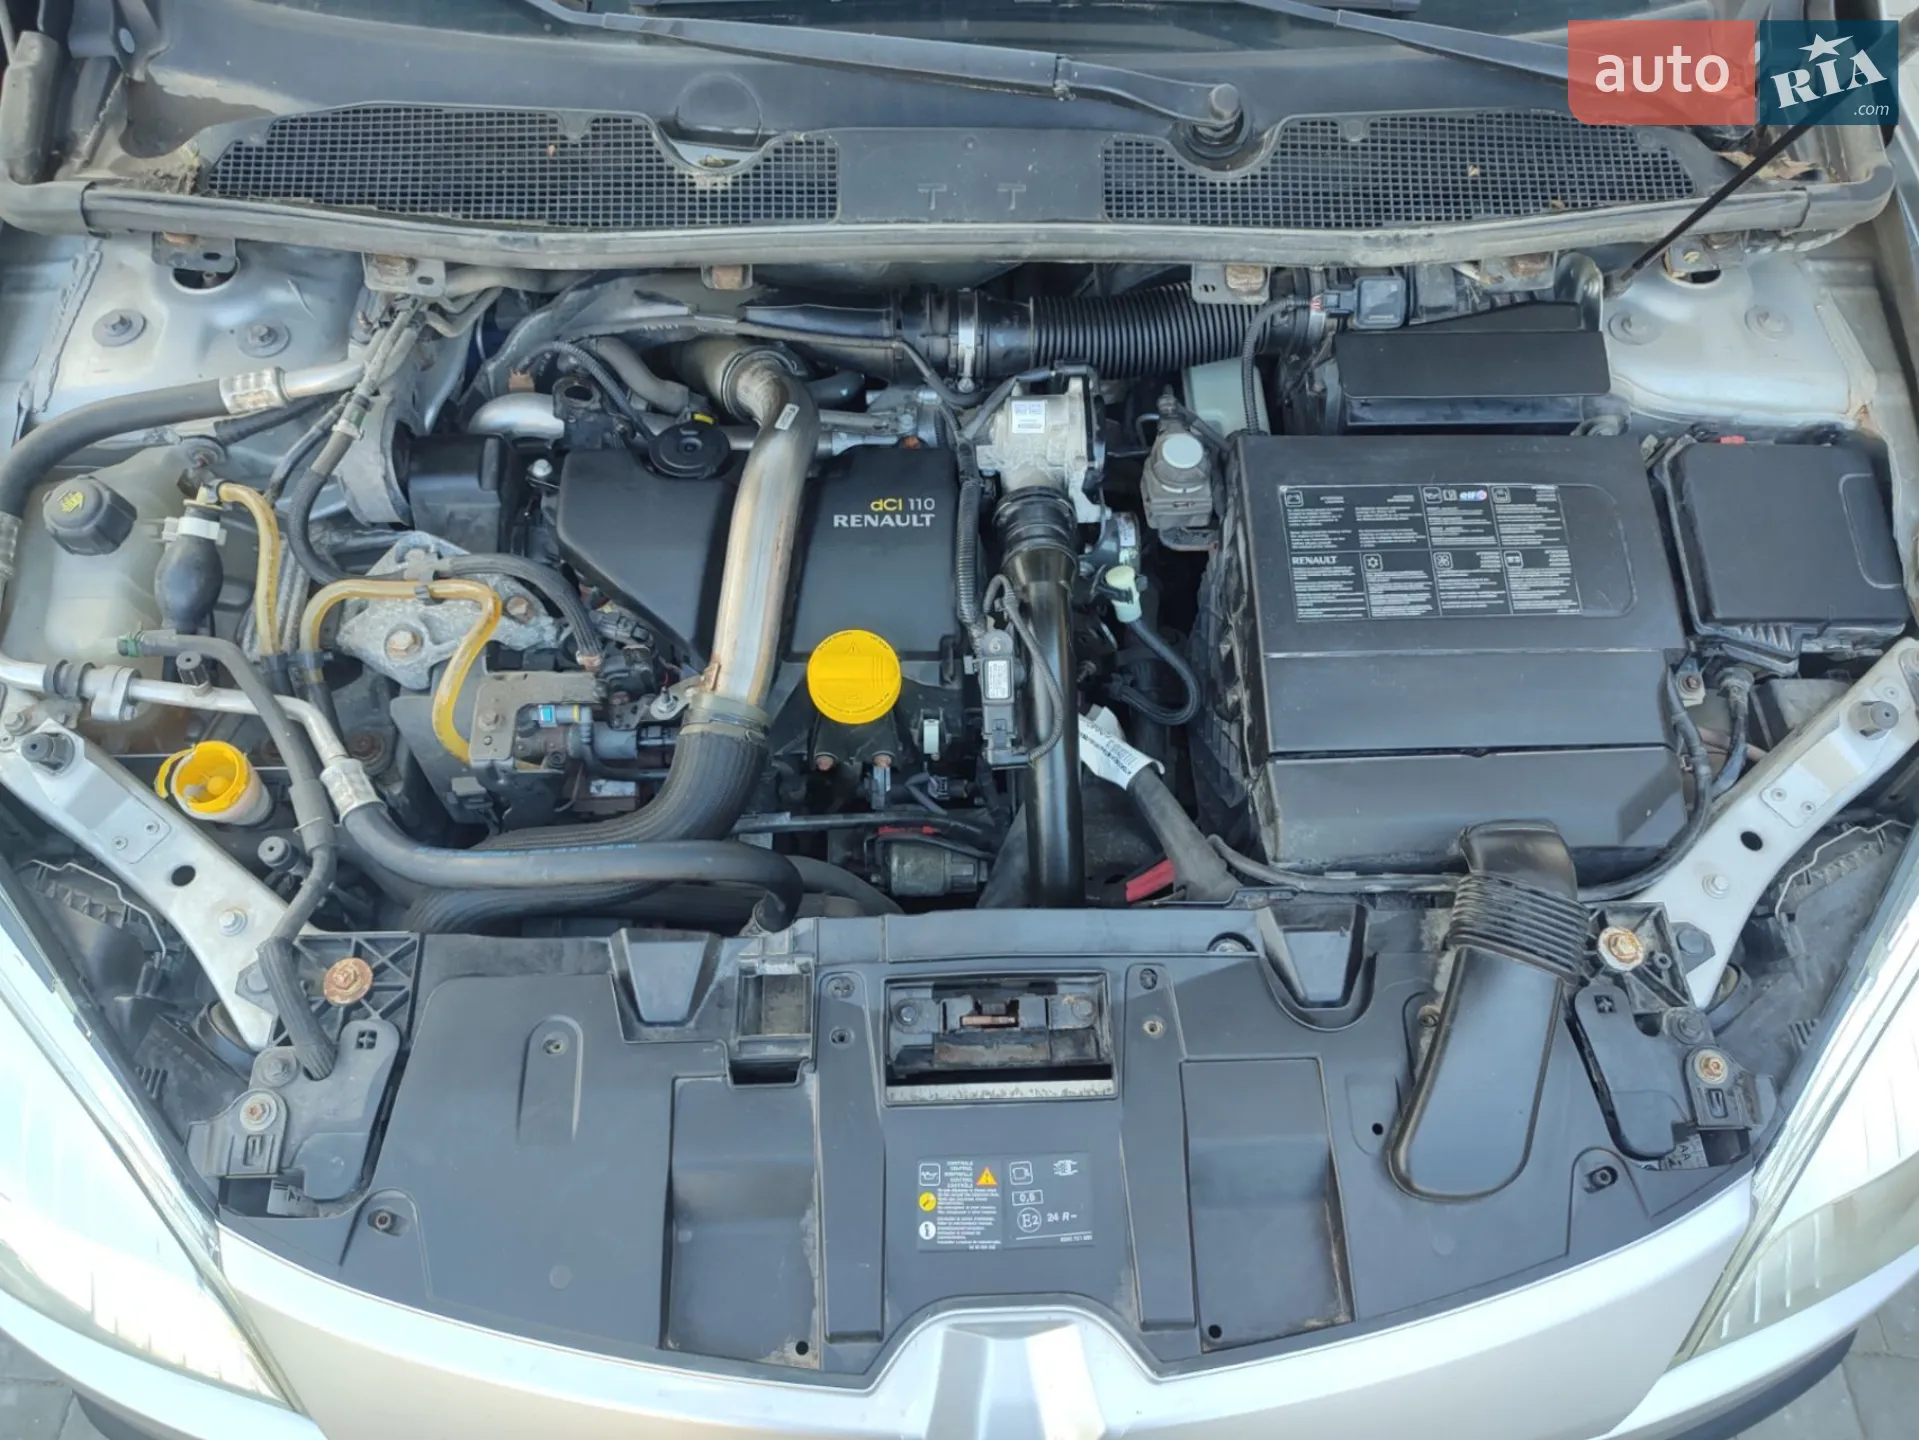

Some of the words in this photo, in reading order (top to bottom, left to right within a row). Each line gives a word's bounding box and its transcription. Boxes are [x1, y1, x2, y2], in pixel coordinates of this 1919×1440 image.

[908, 497, 936, 511] 110
[833, 514, 936, 528] RENAULT
[1291, 555, 1338, 565] RENAULT
[1021, 1213, 1039, 1228] E2
